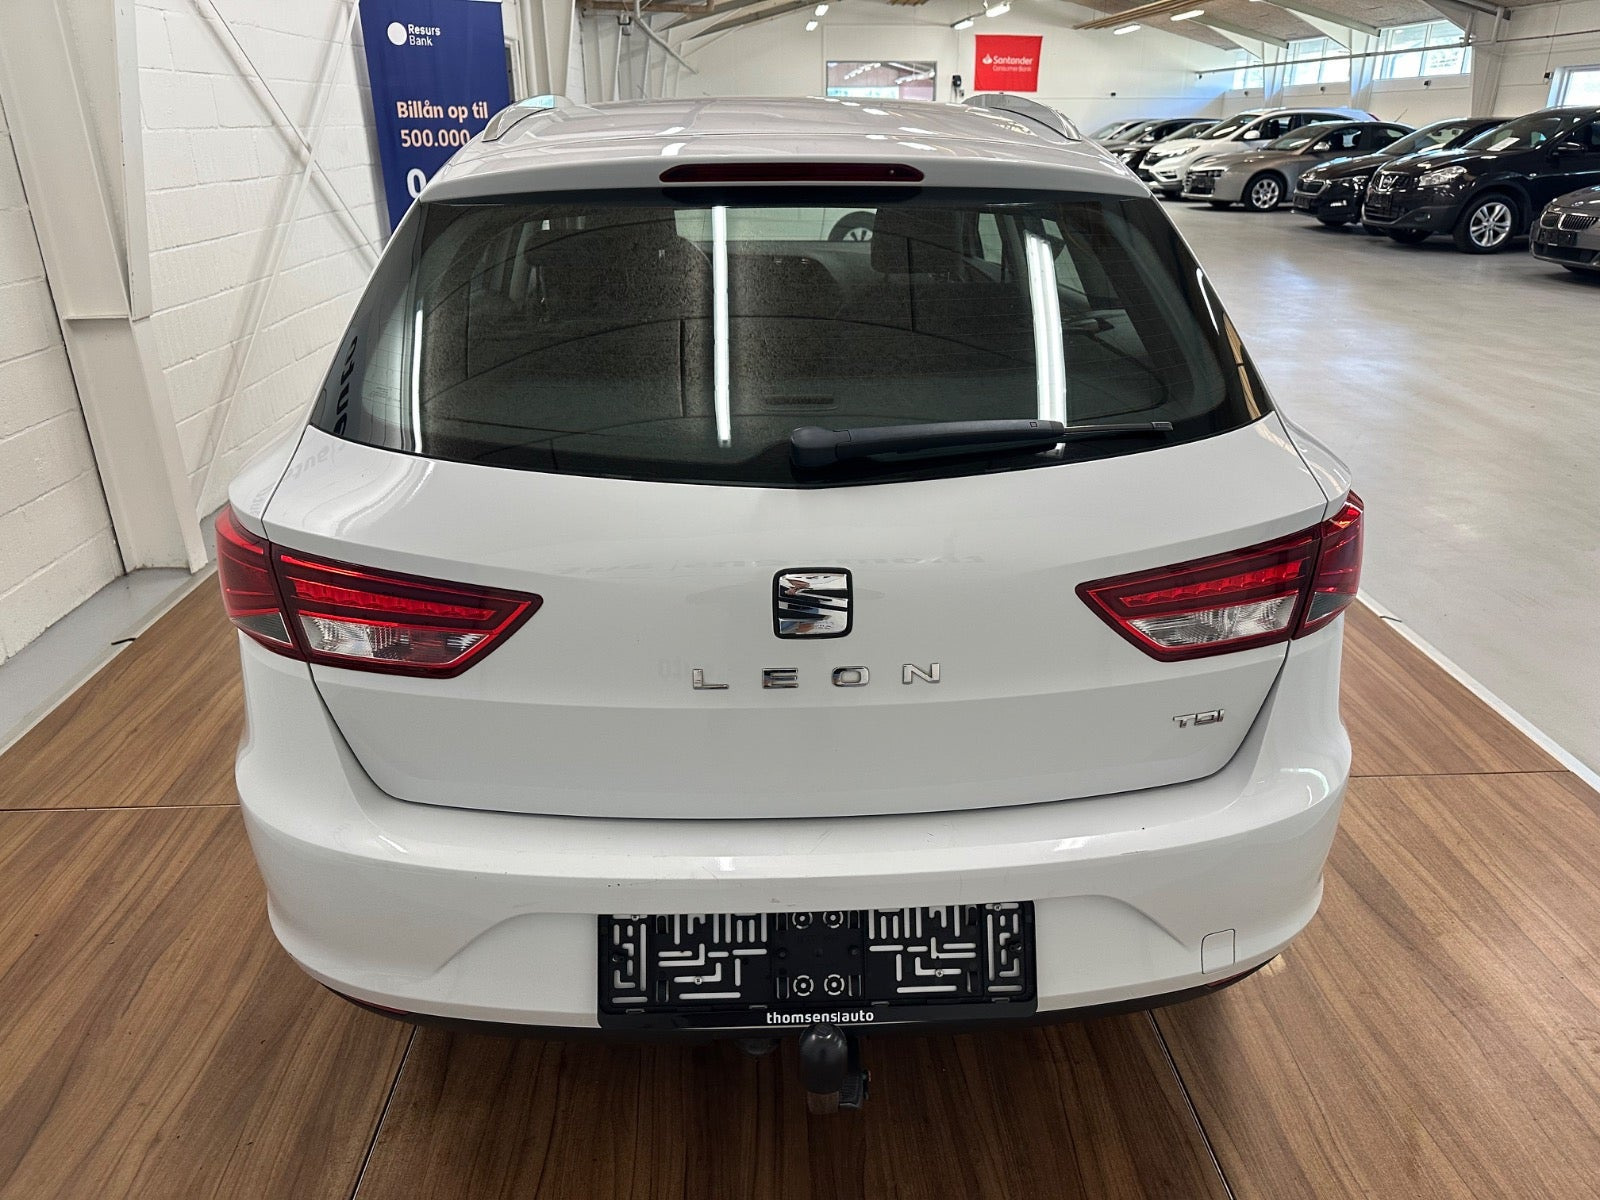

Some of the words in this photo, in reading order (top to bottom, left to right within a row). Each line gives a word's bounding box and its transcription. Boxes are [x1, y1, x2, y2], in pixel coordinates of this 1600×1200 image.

[407, 23, 441, 36] Resurs
[409, 34, 433, 47] Bank
[992, 55, 1033, 65] Santander
[397, 100, 444, 119] Billån
[448, 106, 468, 123] op
[472, 102, 489, 119] til
[401, 129, 471, 148] 500.000
[692, 662, 941, 689] LEON
